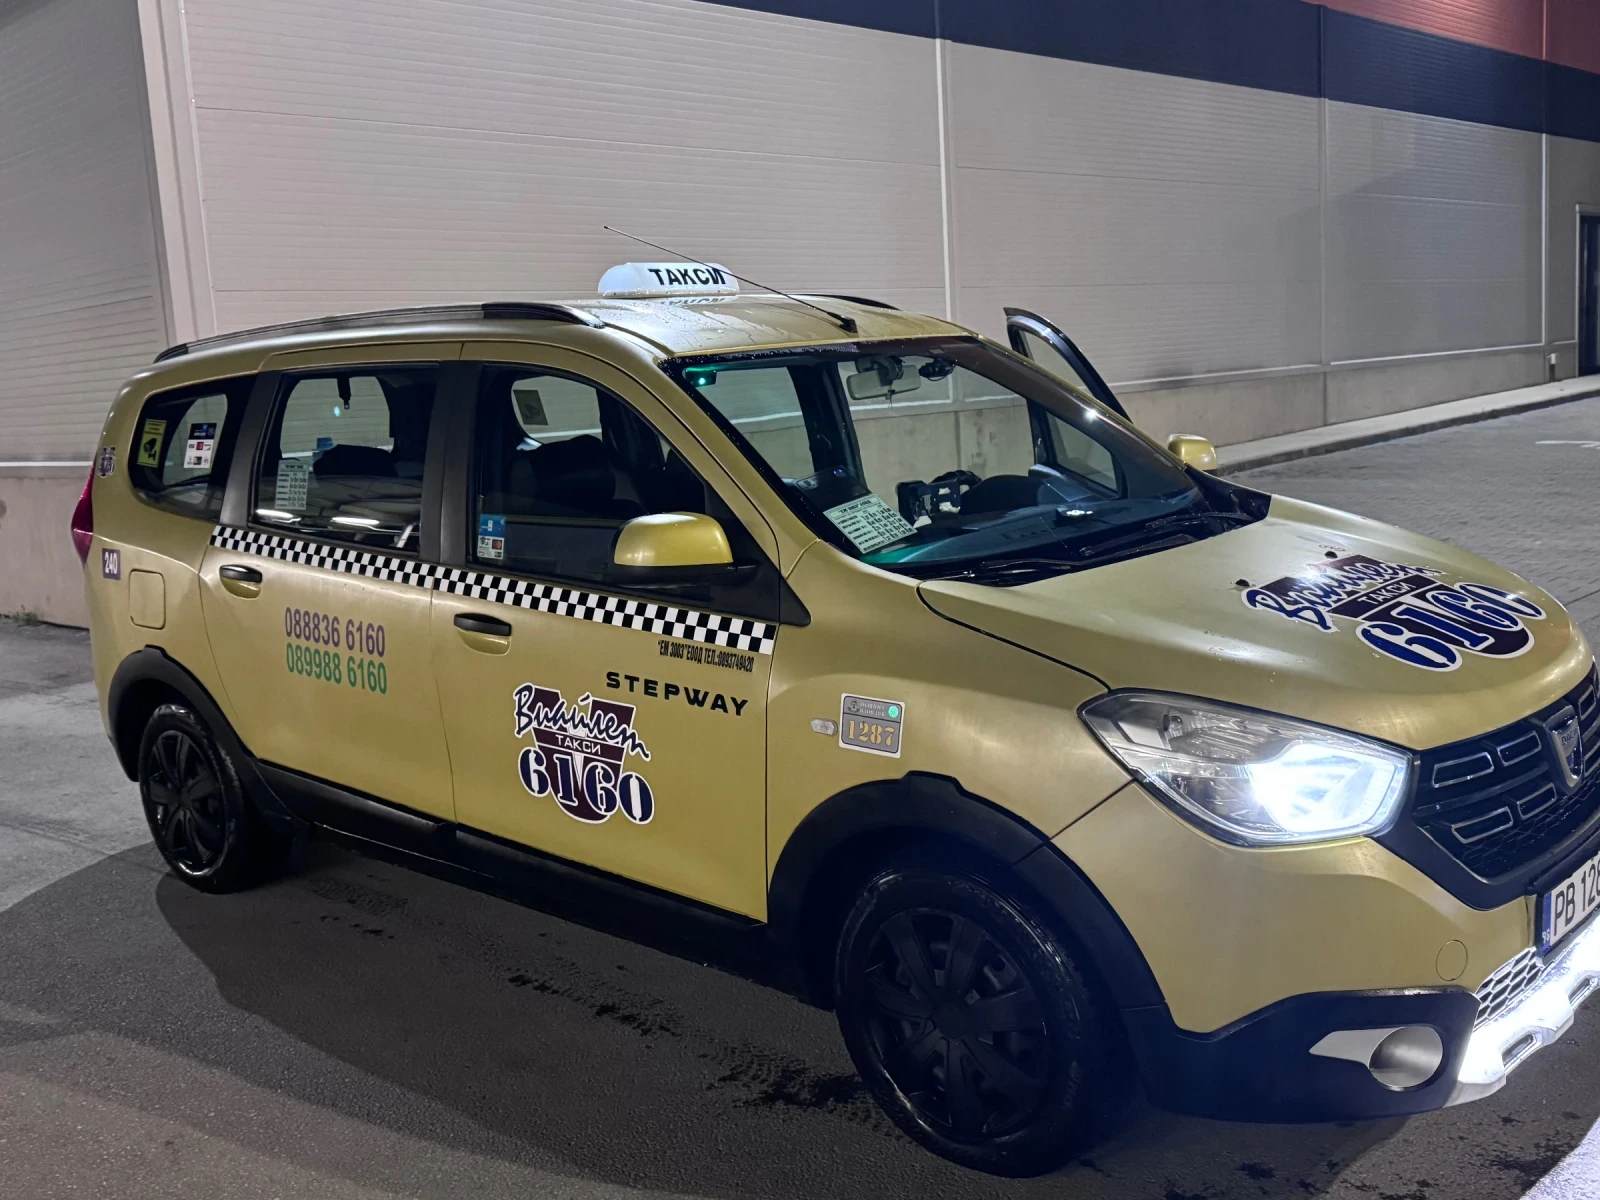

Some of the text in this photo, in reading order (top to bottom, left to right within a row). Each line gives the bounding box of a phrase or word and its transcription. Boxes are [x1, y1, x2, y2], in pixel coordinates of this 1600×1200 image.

[647, 268, 726, 286] ТАКСИ
[104, 551, 118, 575] 240
[1357, 582, 1417, 606] ТАКСИ
[284, 606, 386, 658] 088836 6160
[1359, 583, 1544, 669] 6160
[285, 642, 388, 695] 089988 6160
[605, 671, 749, 716] STEPWAY
[554, 734, 602, 756] ТАКСИ
[848, 720, 896, 747] 1287
[518, 747, 654, 823] 6160
